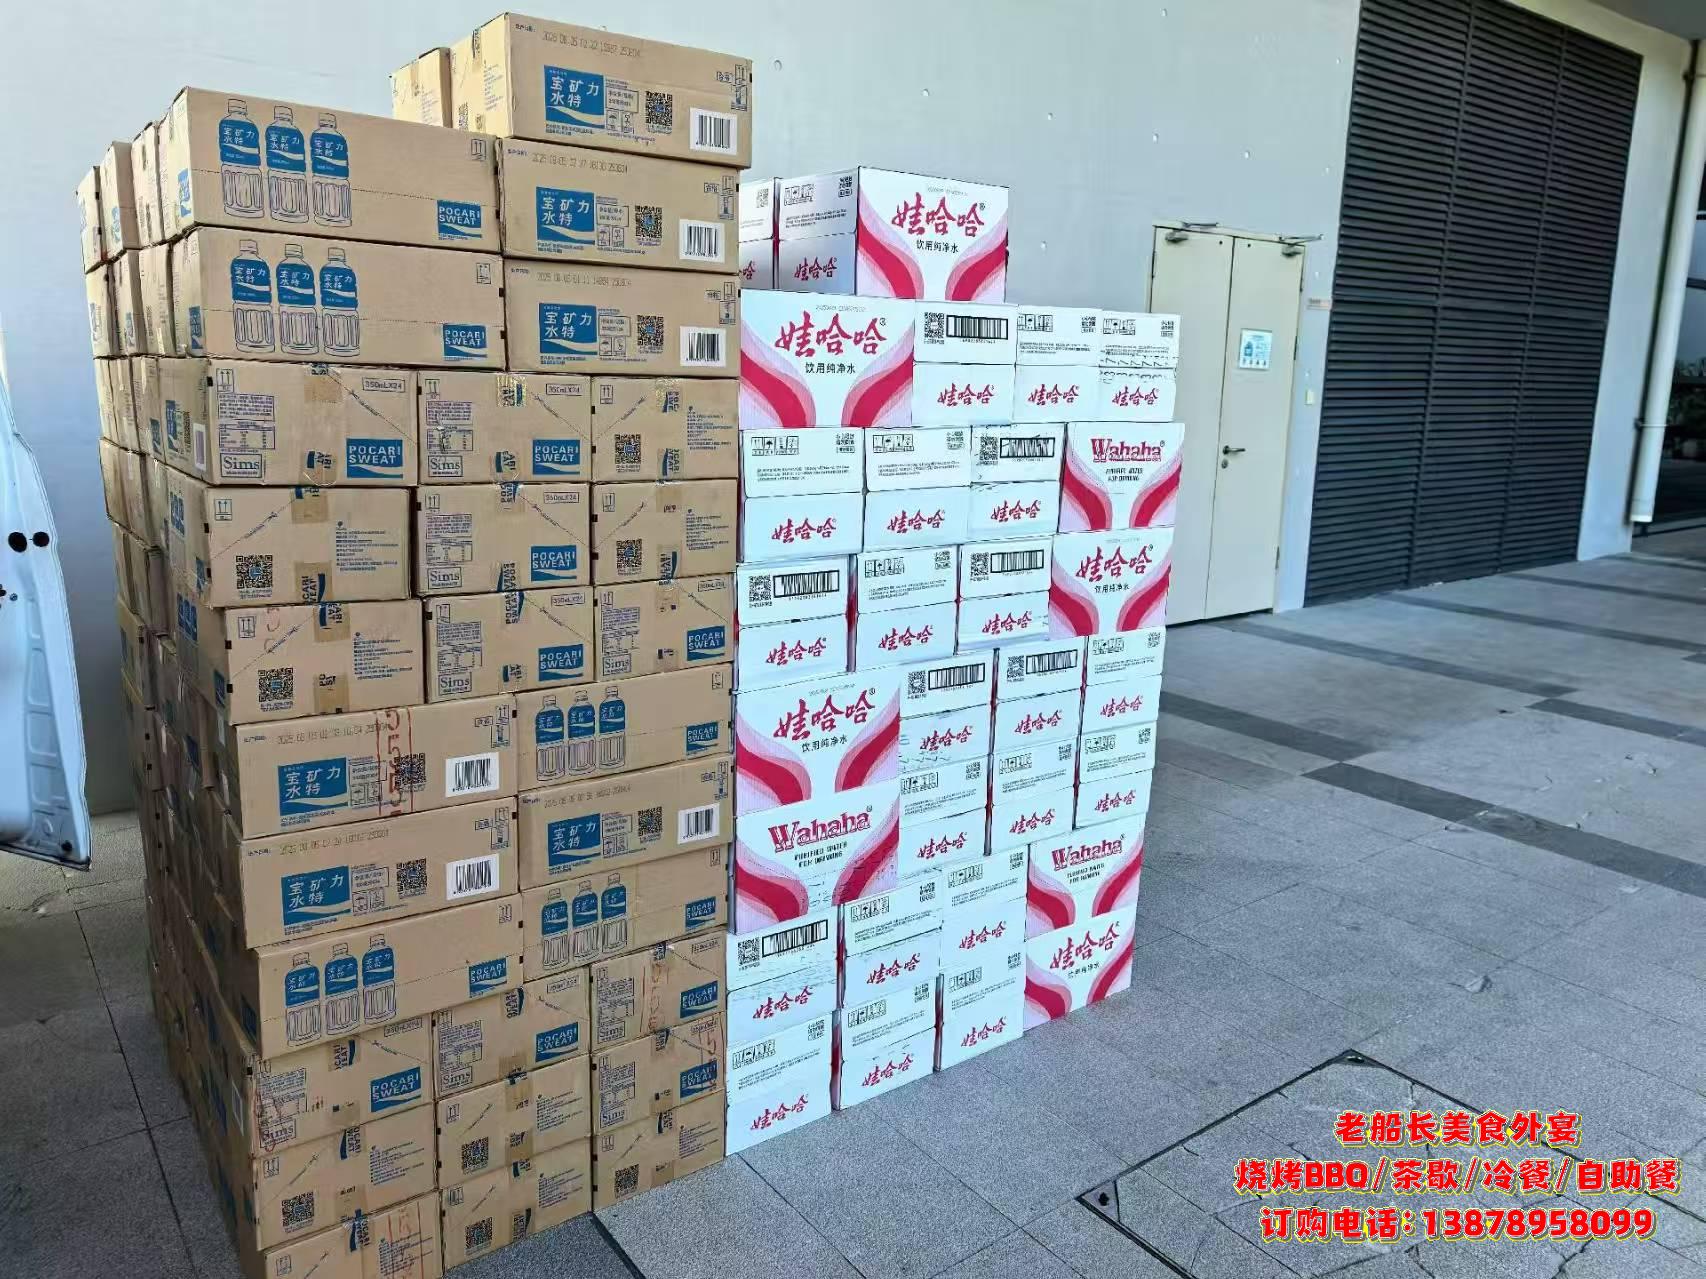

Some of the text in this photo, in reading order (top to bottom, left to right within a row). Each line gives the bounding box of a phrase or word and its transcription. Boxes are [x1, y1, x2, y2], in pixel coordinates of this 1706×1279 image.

[550, 76, 599, 97] 宝矿力
[551, 93, 582, 107] 水特
[439, 206, 480, 219] POCARI
[542, 196, 590, 216] 宝矿力
[891, 192, 985, 237] 娃哈哈
[439, 214, 475, 226] SWEAT
[542, 211, 573, 226] 水特
[916, 239, 958, 253] 饮用纯净水
[794, 257, 836, 280] 娃哈哈
[544, 311, 592, 326] 宝矿力
[444, 329, 486, 341] POCARI
[445, 336, 481, 347] SWEAT
[544, 326, 575, 339] 水特
[775, 310, 887, 357] 娃哈哈
[804, 362, 856, 374] 饮用纯净水
[937, 383, 994, 407] 娃哈哈
[1028, 384, 1078, 406] 娃哈哈
[1112, 387, 1158, 407] 娃哈哈
[349, 446, 401, 455] POCARI
[534, 445, 578, 454] POCARI
[535, 454, 574, 463] SWEAT
[1091, 438, 1161, 462] Wahaha
[222, 456, 260, 470] Sims
[349, 455, 396, 465] SWEAT
[429, 457, 461, 470] Sims
[887, 509, 945, 533] 娃哈哈
[991, 500, 1040, 522] 娃哈哈
[771, 517, 836, 543] 娃哈哈
[532, 551, 576, 562] POCARI
[532, 558, 571, 569] SWEAT
[1076, 545, 1152, 582] 娃哈哈
[429, 570, 460, 582] Sims
[982, 611, 1031, 634] 娃哈哈
[688, 632, 724, 643] POCARI
[688, 640, 720, 650] SWEAT
[879, 625, 932, 650] 娃哈哈
[540, 649, 582, 664] POCARI
[766, 637, 826, 665] 娃哈哈
[540, 658, 578, 670] SWEAT
[604, 657, 630, 670] Sims
[440, 676, 471, 688] Sims
[773, 689, 875, 740] 娃哈哈
[1100, 696, 1143, 717] 娃哈哈
[1014, 710, 1061, 734] 娃哈哈
[920, 726, 972, 751] 娃哈哈
[285, 766, 341, 786] 宝矿力
[285, 784, 321, 798] 水特
[1009, 809, 1055, 834] 娃哈哈
[768, 812, 870, 853] Wahaha
[917, 832, 966, 859] 娃哈哈
[1052, 840, 1122, 871] Wahaha
[289, 874, 344, 895] 宝矿力
[289, 892, 323, 907] 水特
[959, 921, 1005, 949] 娃哈哈
[1050, 923, 1119, 969] 娃哈哈
[867, 954, 920, 984] 娃哈哈
[753, 986, 812, 1019] 娃哈哈
[961, 1017, 1006, 1047] 娃哈哈
[862, 1053, 913, 1086] 娃哈哈
[372, 1073, 420, 1094] POCARI
[372, 1083, 415, 1102] SWEAT
[750, 1094, 808, 1130] 娃哈哈
